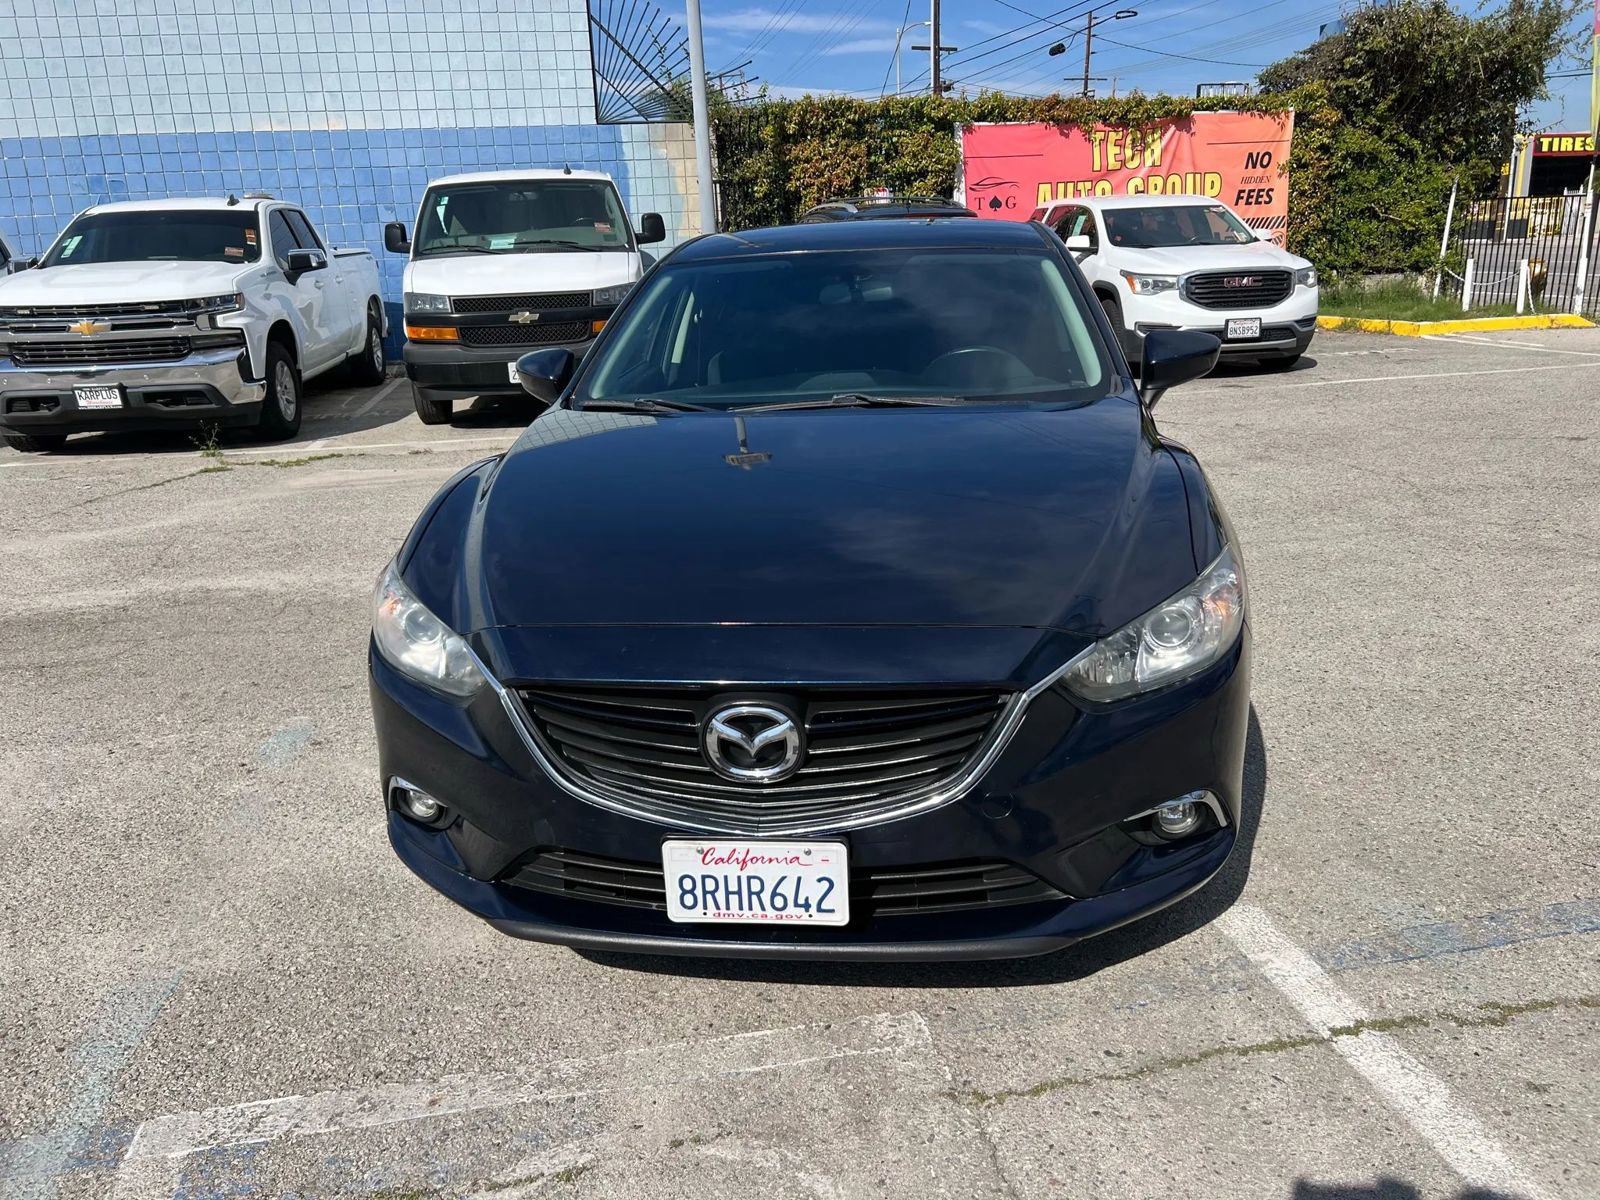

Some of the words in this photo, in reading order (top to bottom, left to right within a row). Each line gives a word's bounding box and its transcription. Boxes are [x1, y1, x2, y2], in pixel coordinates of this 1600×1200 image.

[1088, 127, 1162, 172] TECH
[1540, 136, 1595, 152] TIRES
[1245, 151, 1272, 169] NO
[1240, 175, 1272, 184] HIDDEN
[1036, 179, 1113, 206] AUTO
[1234, 187, 1274, 206] FEES
[974, 197, 985, 210] T
[1005, 195, 1017, 209] G
[1223, 276, 1264, 288] GMC
[1229, 326, 1259, 336] 8NSB952
[77, 390, 118, 400] KARPLUS
[701, 847, 813, 871] California
[678, 874, 835, 913] 8RHR642
[713, 911, 803, 920] dmv.ca.gov
